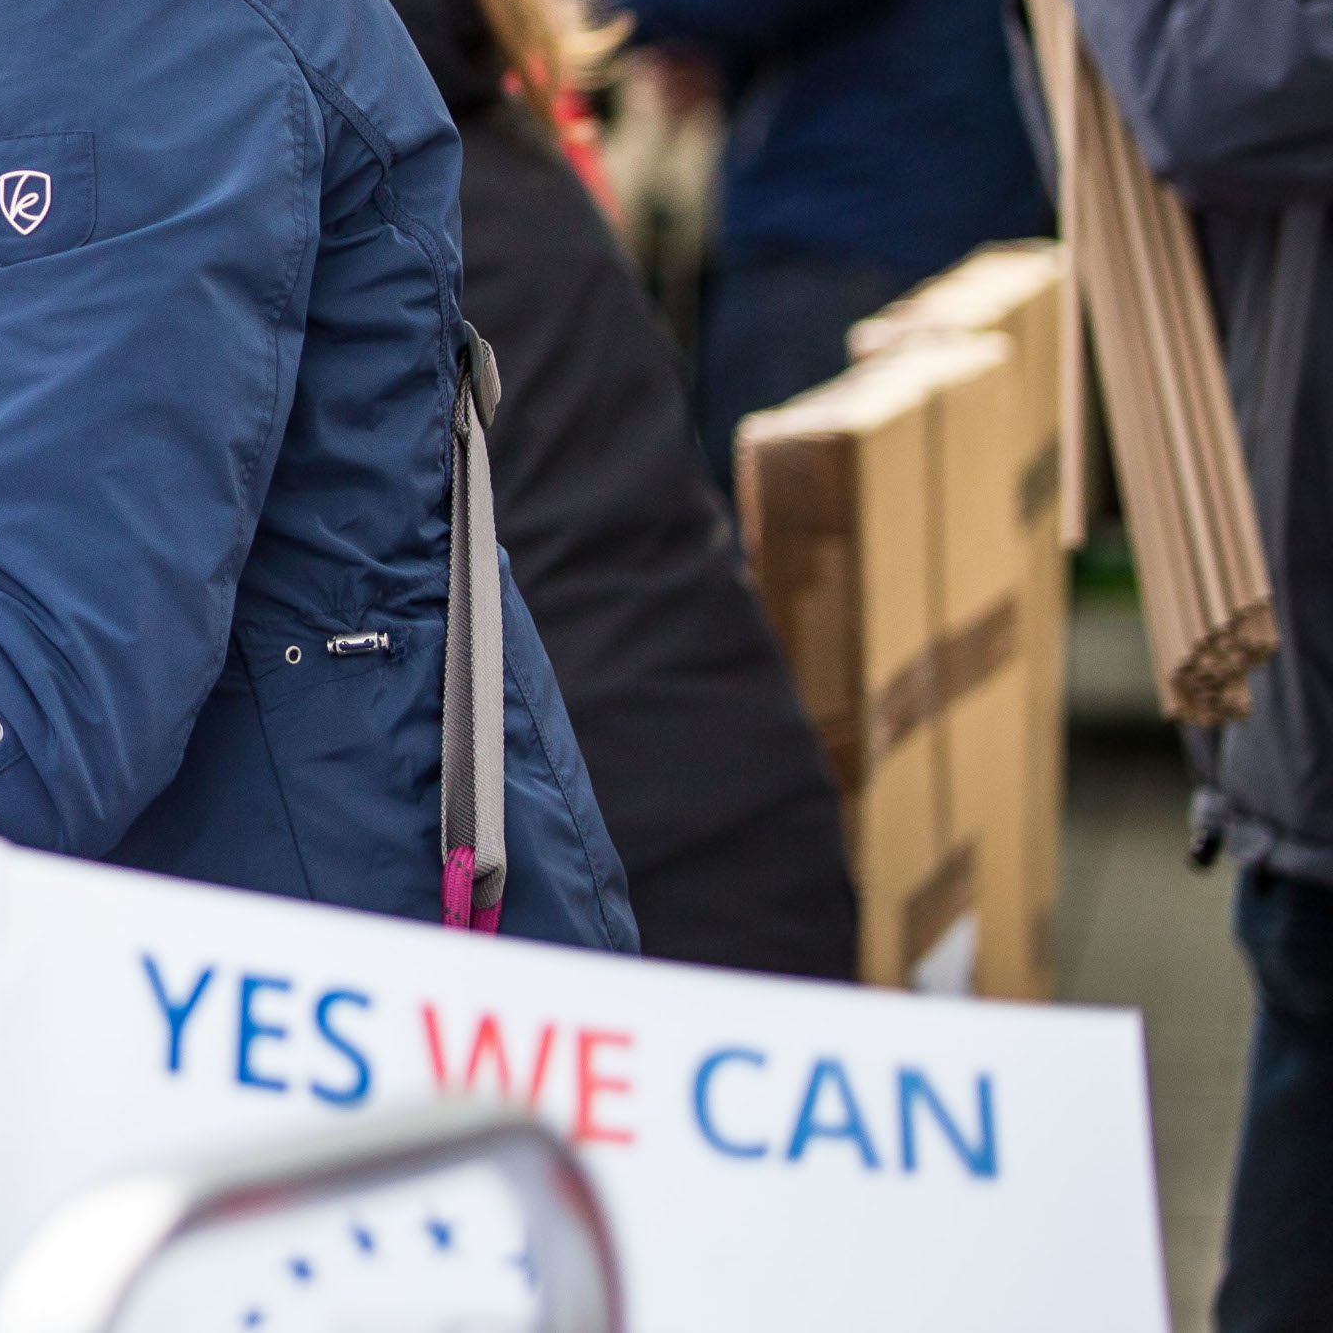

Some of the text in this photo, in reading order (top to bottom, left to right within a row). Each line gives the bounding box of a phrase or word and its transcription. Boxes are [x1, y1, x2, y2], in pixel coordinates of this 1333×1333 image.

[141, 951, 1001, 1180] YES WE CAN
